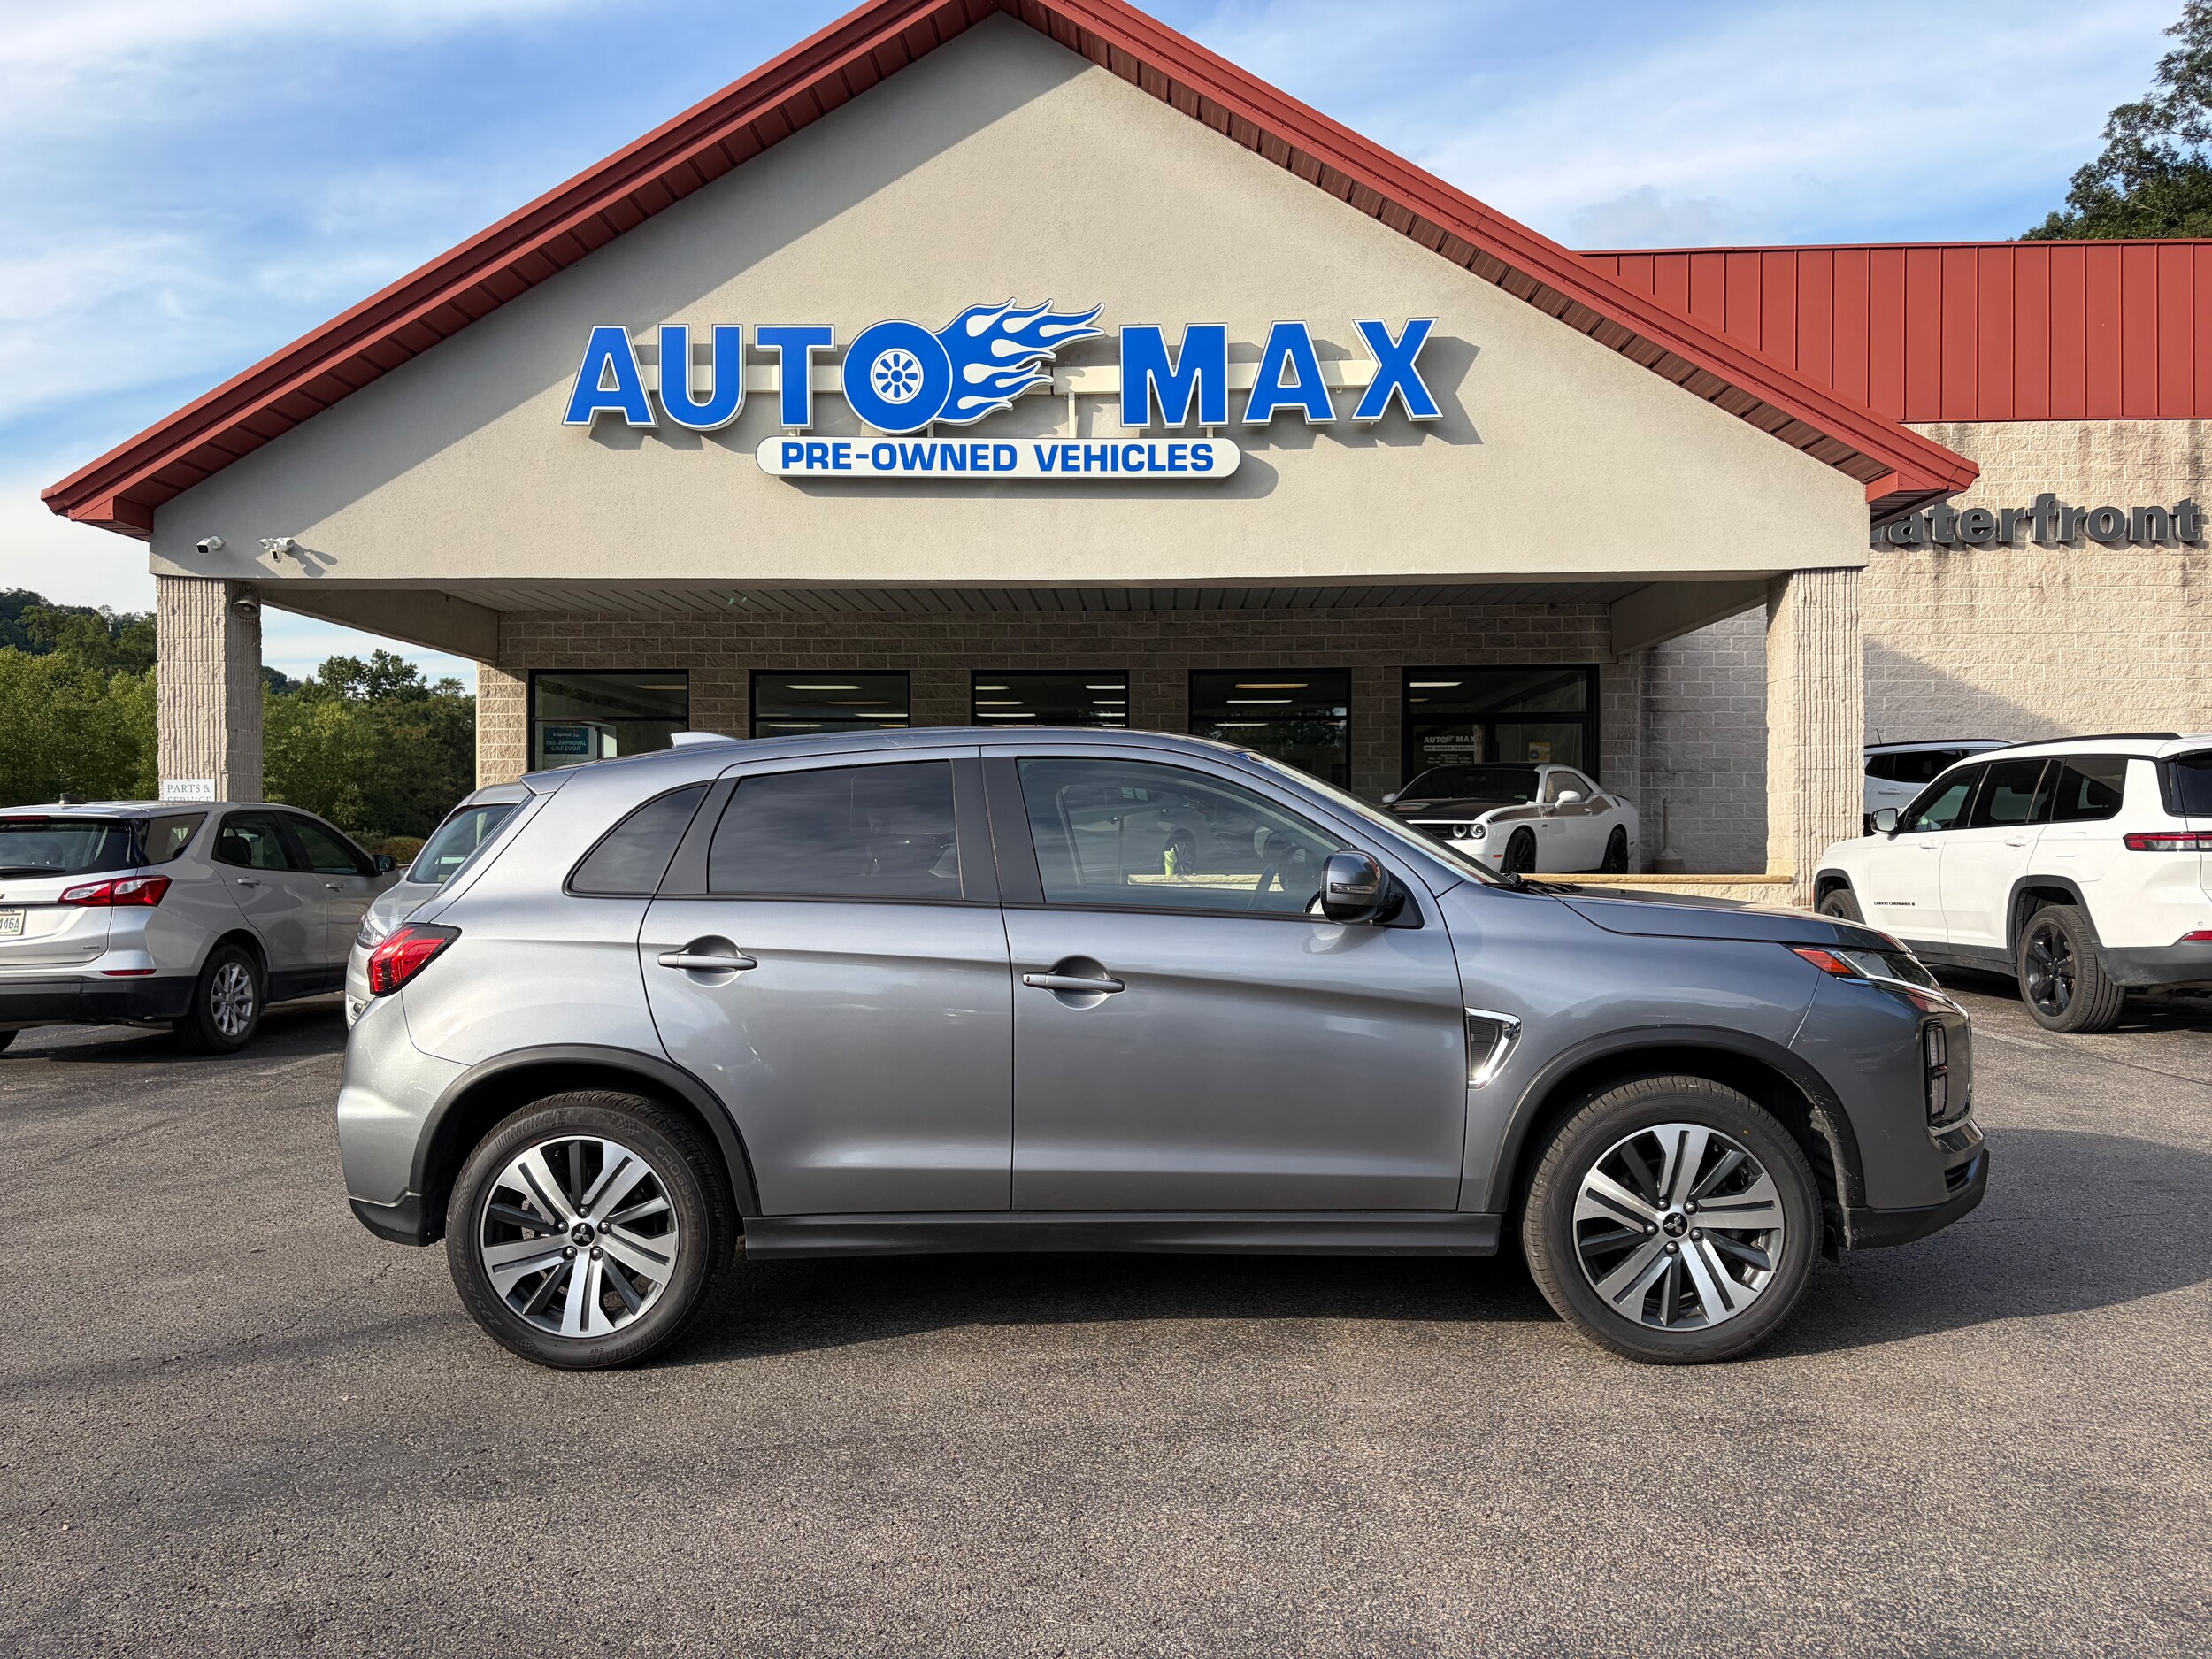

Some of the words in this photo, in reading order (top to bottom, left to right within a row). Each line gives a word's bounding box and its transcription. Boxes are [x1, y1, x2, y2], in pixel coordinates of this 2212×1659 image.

[562, 319, 953, 434] AUTO
[1119, 317, 1444, 429] MAX
[781, 442, 1018, 472] PRE-OWNED
[1033, 442, 1215, 472] VEHICLES
[1870, 493, 2200, 543] aterfront
[167, 784, 200, 793] PARTS
[203, 784, 211, 793] &
[654, 1145, 701, 1240] CROSSOVER
